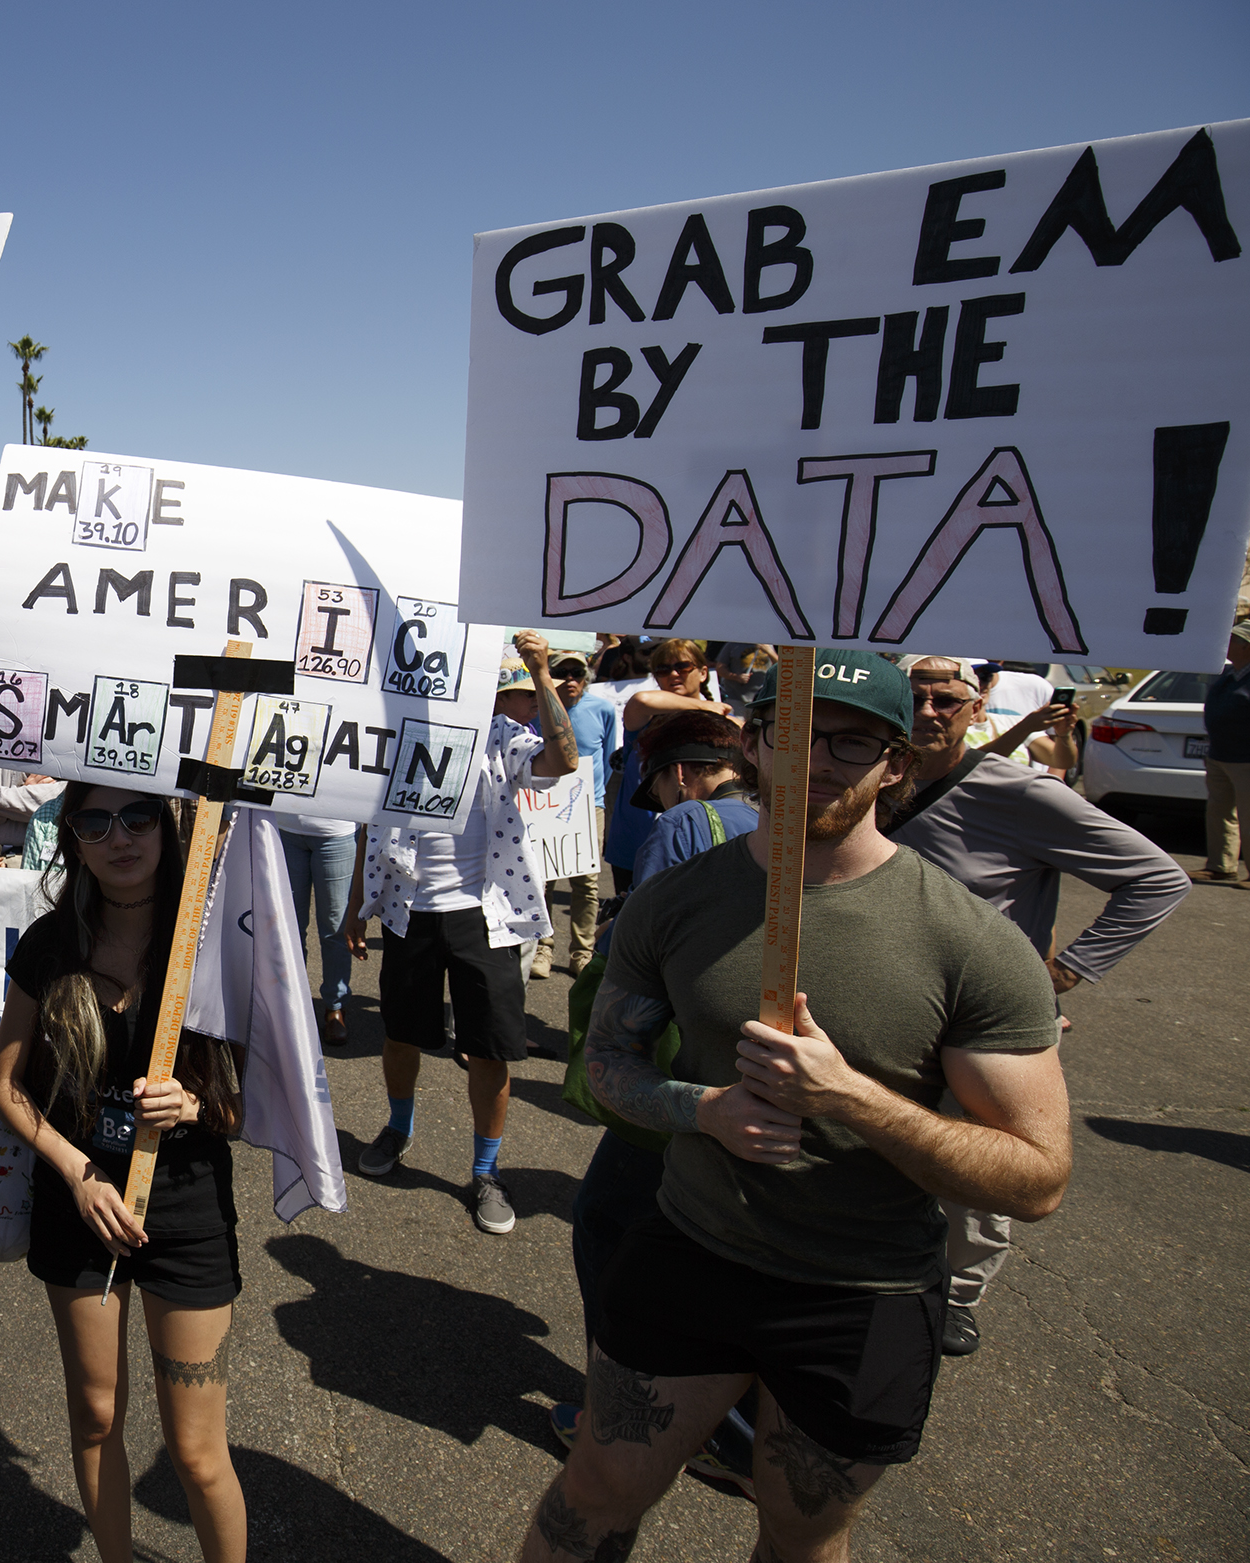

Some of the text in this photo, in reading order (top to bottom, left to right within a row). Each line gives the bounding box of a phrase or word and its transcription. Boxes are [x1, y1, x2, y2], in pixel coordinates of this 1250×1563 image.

[495, 126, 1241, 335] GRAB EM
[576, 292, 1026, 441] BY THE
[78, 521, 139, 545] 39.10
[318, 588, 438, 617] 53 20
[298, 655, 447, 696] 126.90 40.08
[779, 658, 793, 702] HOME
[814, 663, 870, 684] OLF
[114, 682, 139, 698] 18
[279, 701, 300, 713] 47
[229, 705, 238, 718] 611
[225, 720, 235, 744] SKU#
[776, 706, 791, 753] DEPOT
[92, 747, 153, 770] 39.95
[246, 767, 310, 789] 107.87
[393, 790, 455, 813] 14.09
[767, 785, 785, 945] HOME OF THE FINEST PAINTS
[183, 834, 214, 968] HOME OF THE FINEST PAINTS
[163, 1033, 176, 1067] HOME
[170, 994, 184, 1030] DEPOT
[103, 1116, 131, 1142] Be
